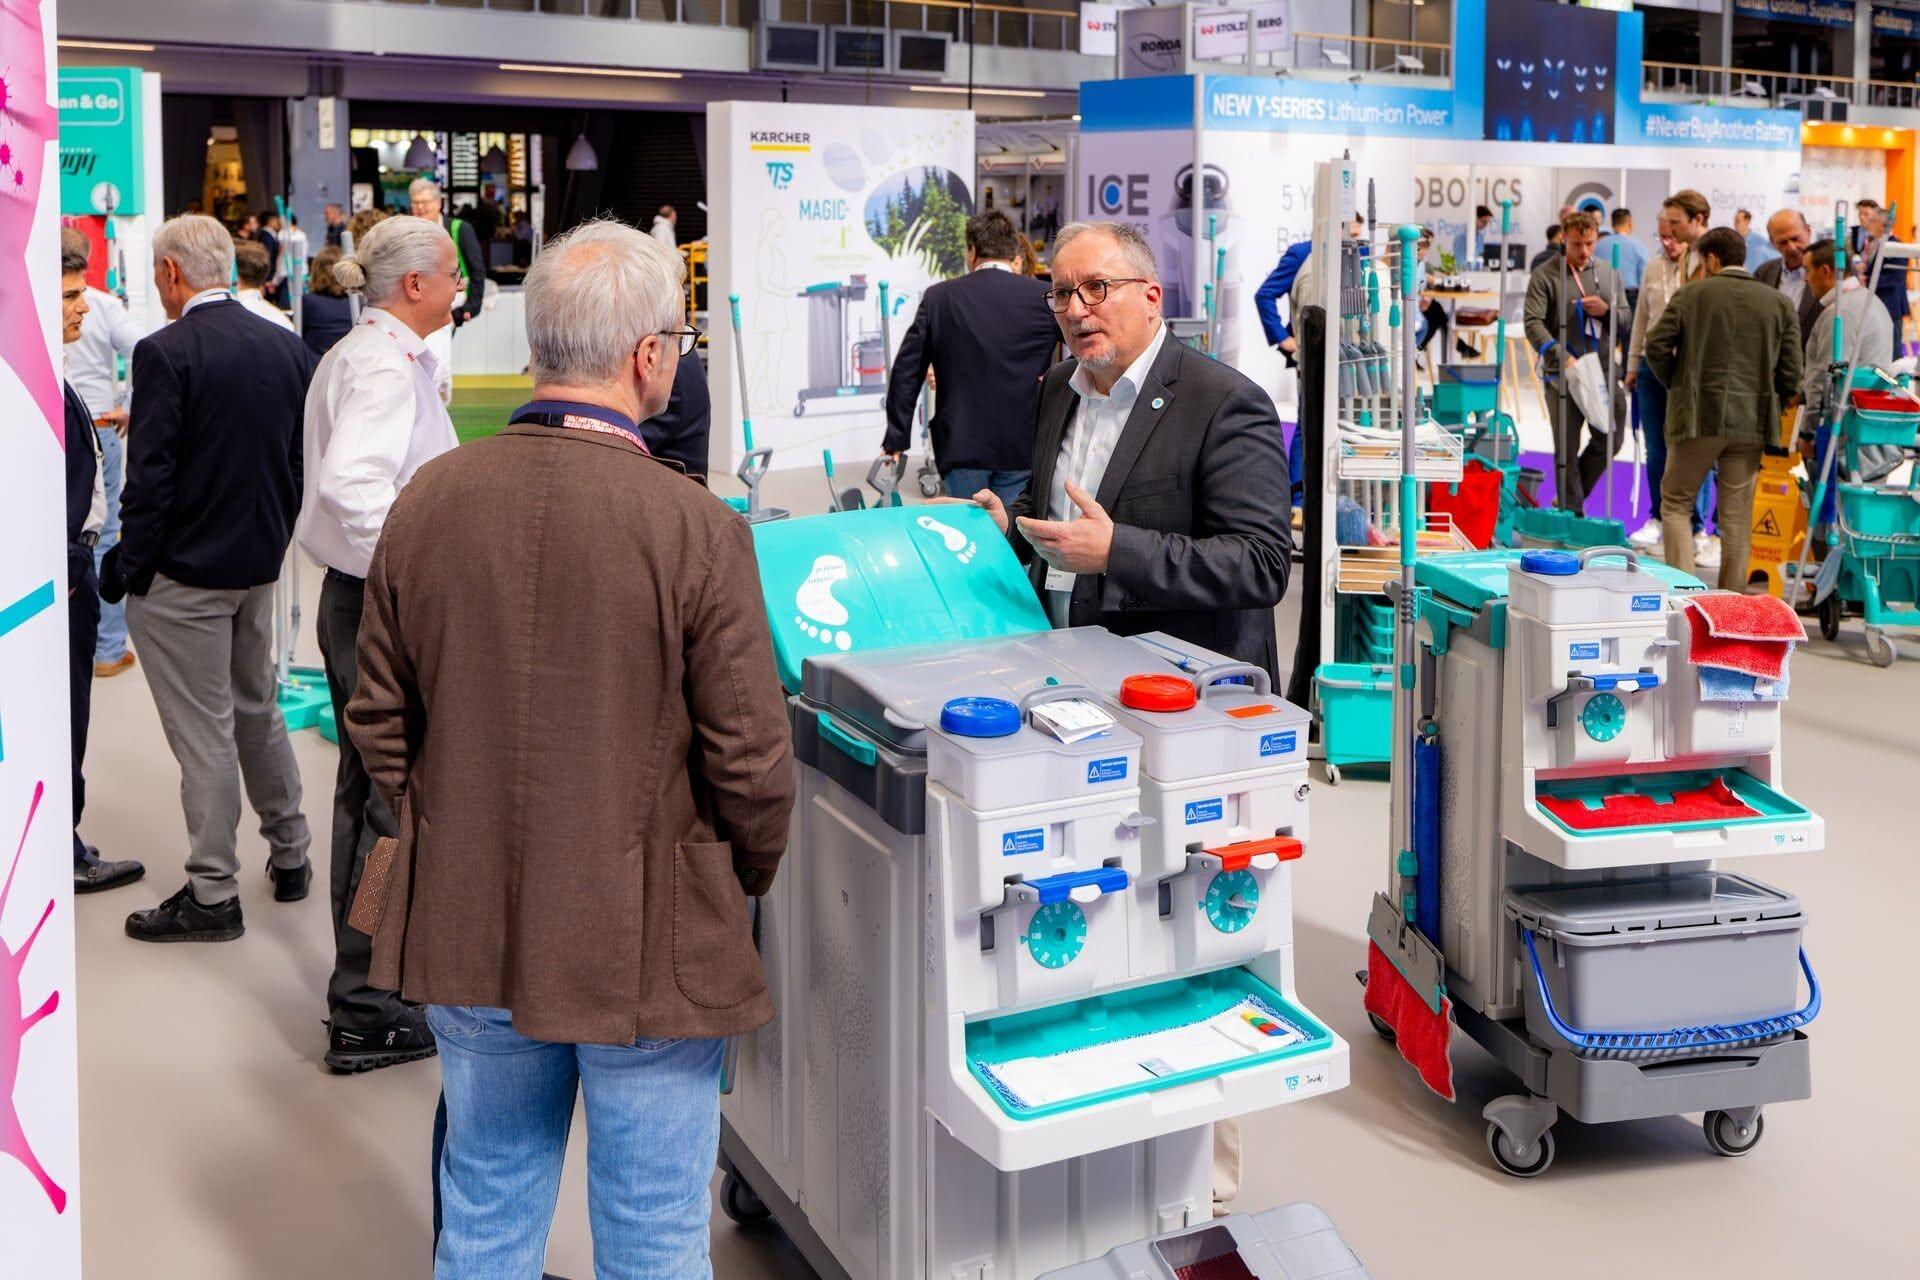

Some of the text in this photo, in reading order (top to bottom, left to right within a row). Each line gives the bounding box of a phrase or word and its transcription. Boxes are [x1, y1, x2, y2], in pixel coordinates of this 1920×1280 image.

[95, 94, 118, 109] Go
[1213, 93, 1448, 126] NEW Y-SERIES Lithium-ion Power
[1645, 114, 1795, 148] #NeverBuyAnotherBattery
[1088, 173, 1149, 216] ICE
